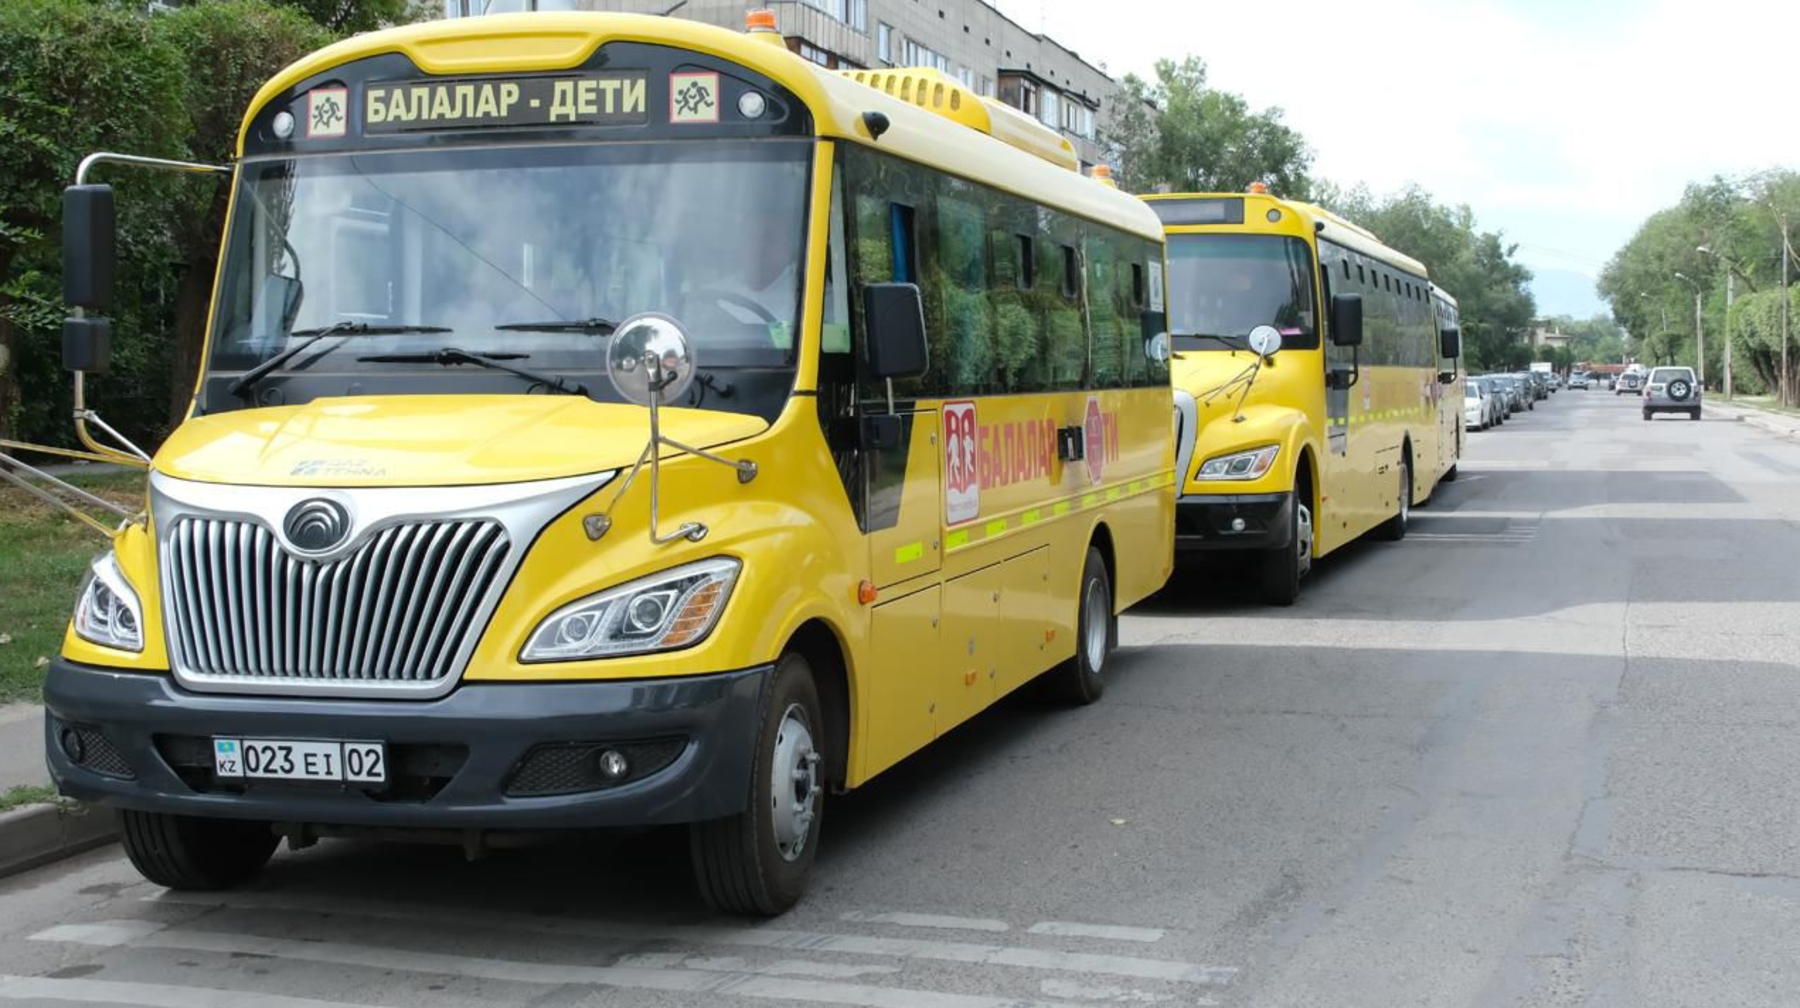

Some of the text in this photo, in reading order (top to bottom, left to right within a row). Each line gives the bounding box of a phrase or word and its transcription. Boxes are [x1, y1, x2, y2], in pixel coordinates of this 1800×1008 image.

[367, 83, 519, 123] БАЛАЛАР
[549, 78, 647, 122] ДЕТИ
[980, 418, 1056, 489] БАЛАЛАР
[218, 760, 237, 773] KZ
[244, 745, 382, 777] 023 EI 02
